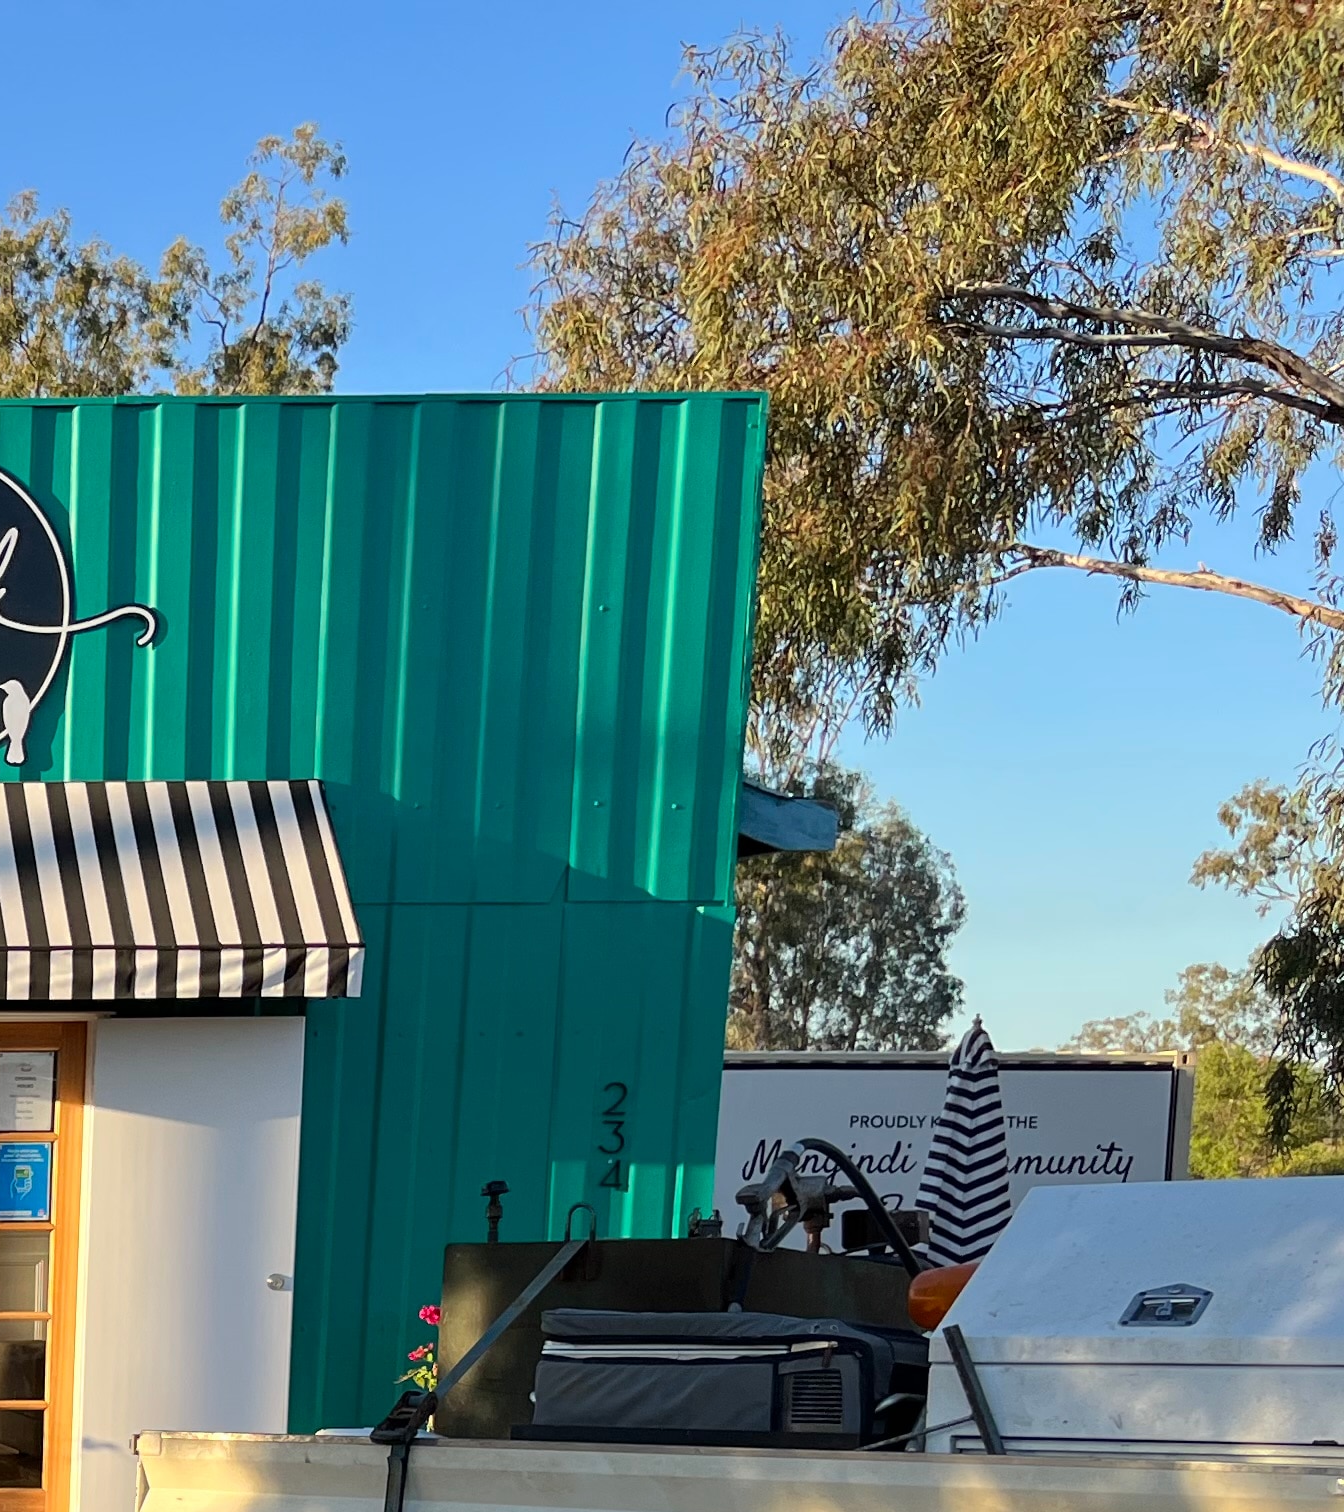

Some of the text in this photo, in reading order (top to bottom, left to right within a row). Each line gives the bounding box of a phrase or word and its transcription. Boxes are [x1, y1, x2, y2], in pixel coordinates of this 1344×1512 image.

[849, 1115, 926, 1129] PROUDLY
[1007, 1116, 1038, 1129] THE
[742, 1138, 1134, 1184] Mngindi munity
